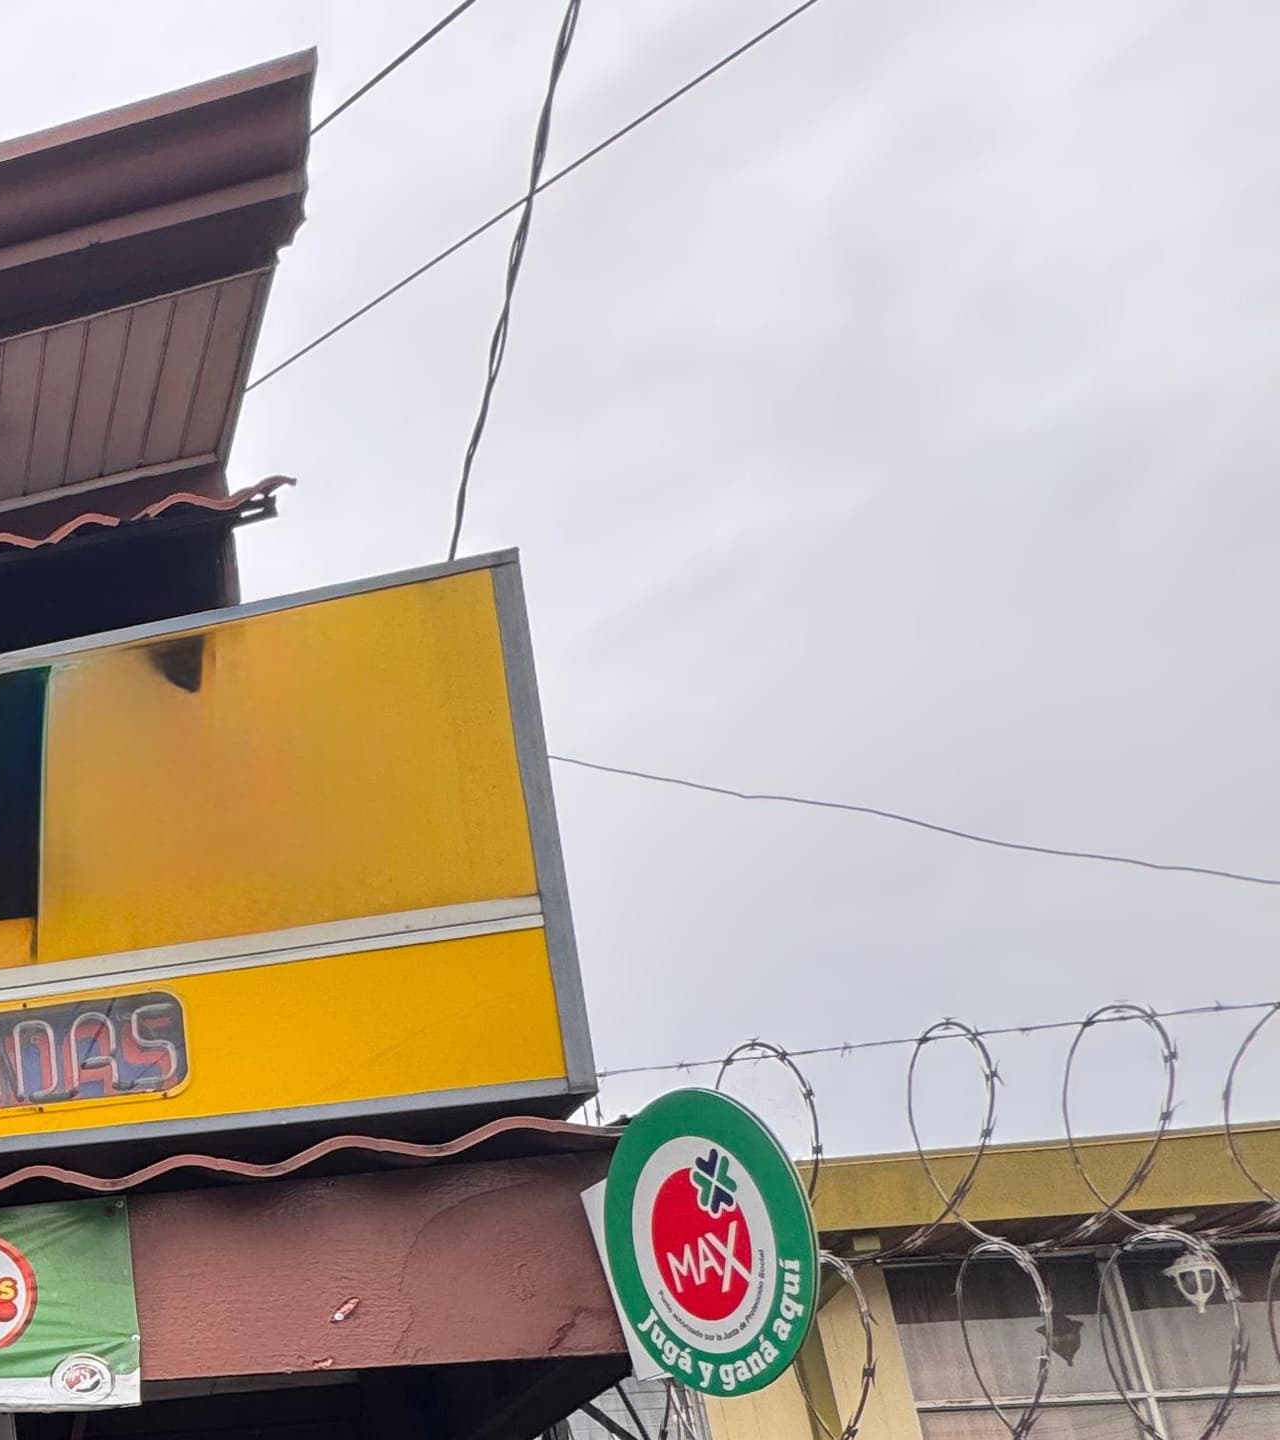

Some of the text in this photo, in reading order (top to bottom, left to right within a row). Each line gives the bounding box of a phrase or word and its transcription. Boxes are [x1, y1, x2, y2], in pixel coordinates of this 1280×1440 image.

[667, 1220, 752, 1293] MAX
[638, 1258, 805, 1390] Jugá y ganá aquí
